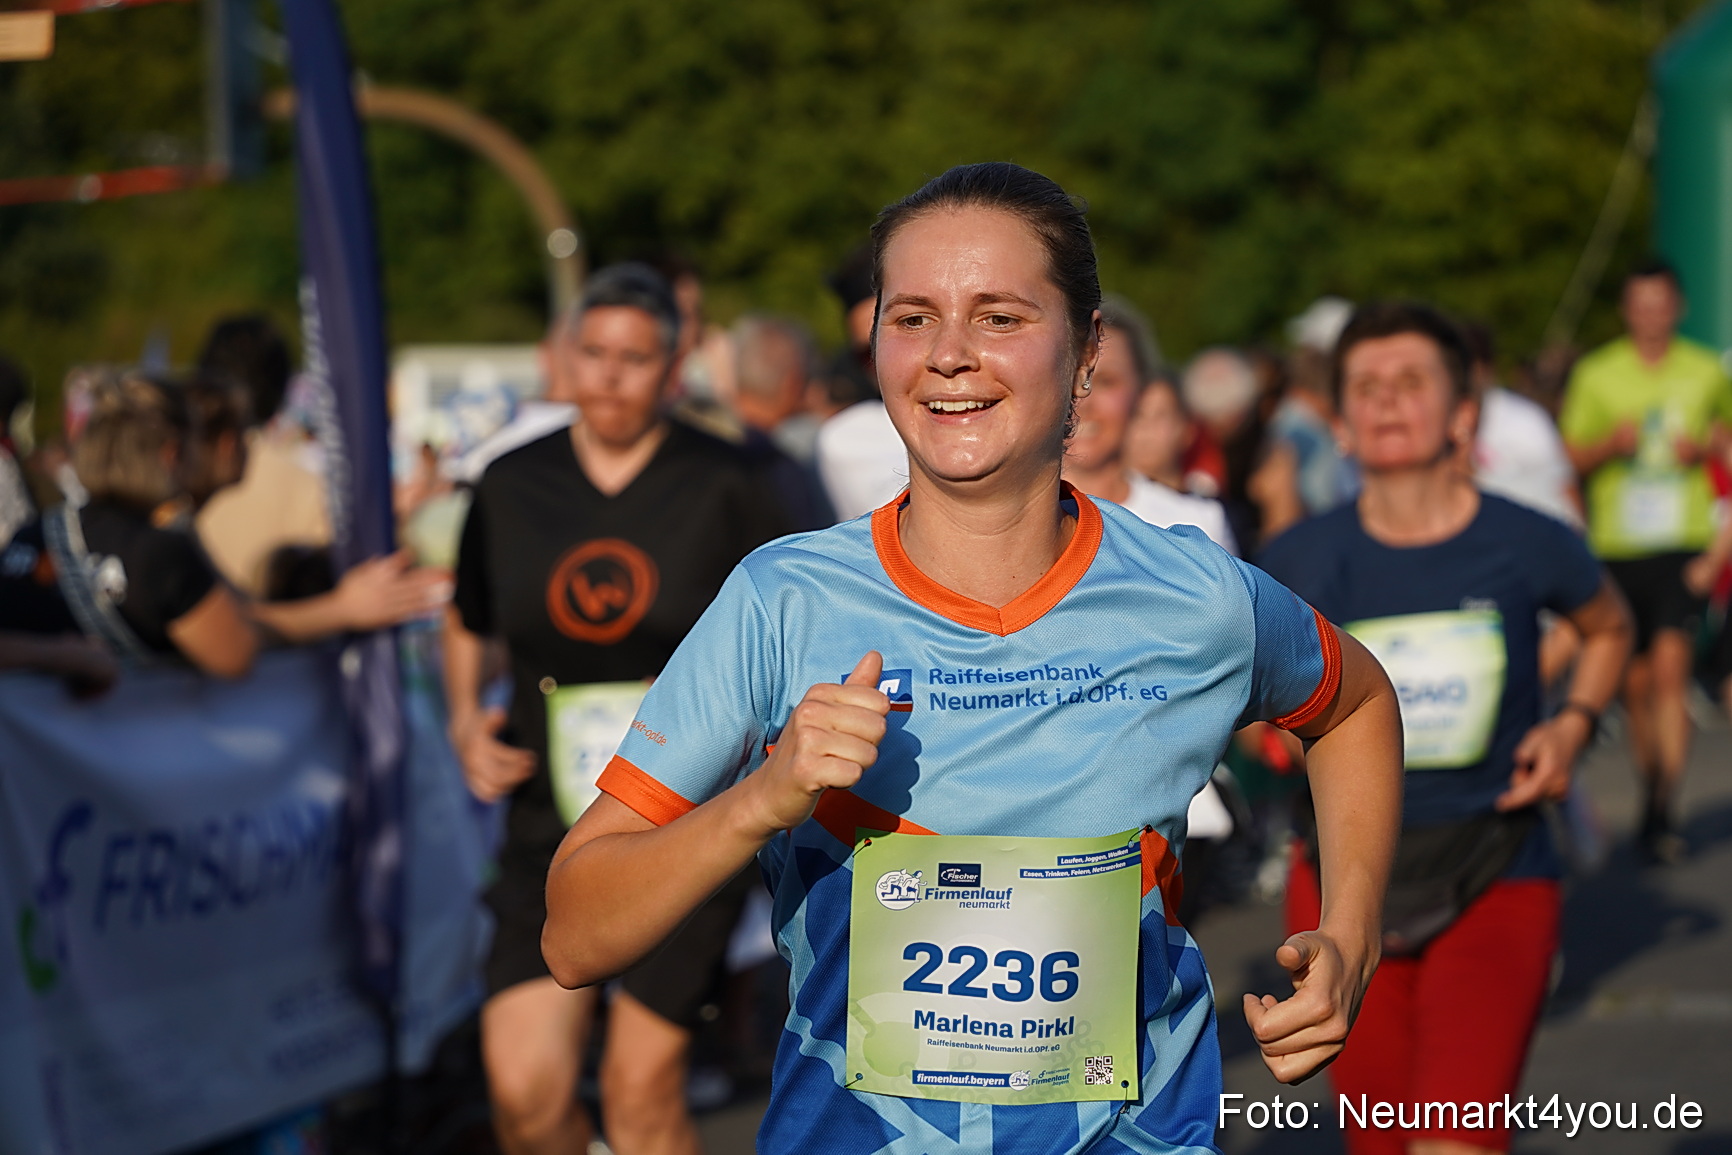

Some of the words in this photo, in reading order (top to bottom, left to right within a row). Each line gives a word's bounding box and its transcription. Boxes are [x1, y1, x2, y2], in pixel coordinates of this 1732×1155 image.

[929, 663, 1104, 686] Raiffeisenbank
[929, 688, 1049, 711] Neumarkt
[1056, 684, 1135, 706] i.d.OPf.
[1139, 685, 1168, 702] eG
[1060, 856, 1084, 866] Laufen,
[1084, 852, 1108, 863] Joggen,
[1107, 848, 1129, 859] Walken
[1023, 869, 1045, 879] Essen,
[1044, 868, 1070, 878] Trinken,
[1070, 866, 1092, 876] Feiern,
[1091, 861, 1126, 874] Netzwerken
[924, 887, 1013, 901] Firmenlauf
[958, 900, 1011, 910] neumarkt
[902, 942, 1080, 1002] 2236
[913, 1010, 1014, 1039] Marlena
[1020, 1016, 1075, 1039] Pirkl
[926, 1038, 985, 1050] Raiffeisenbank
[984, 1043, 1024, 1054] Neumarkt
[1050, 1043, 1061, 1051] eG
[916, 1072, 1006, 1087] firmenlauf.bayern
[1031, 1073, 1071, 1086] Firmenlauf
